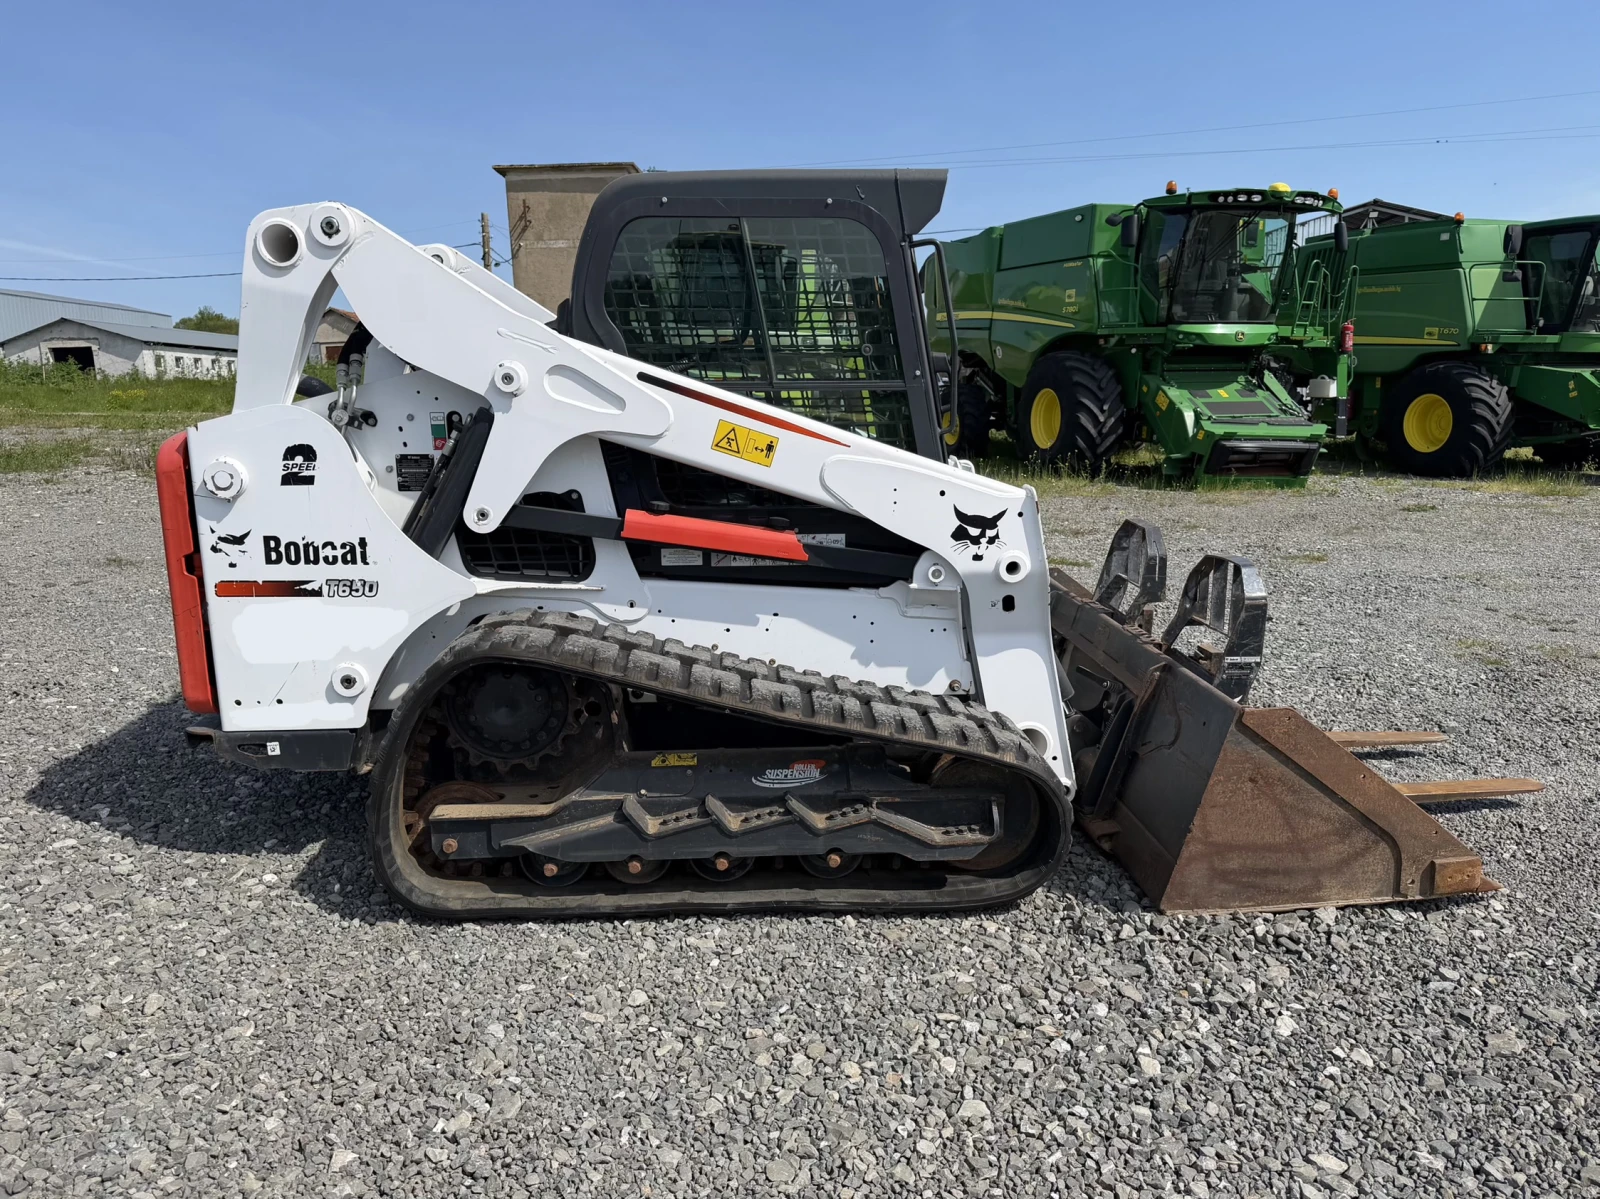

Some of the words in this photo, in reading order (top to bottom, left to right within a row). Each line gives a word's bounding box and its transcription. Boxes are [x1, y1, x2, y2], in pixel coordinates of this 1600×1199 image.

[280, 443, 317, 486] 2
[262, 535, 370, 565] Bobcat
[325, 578, 379, 597] T650
[765, 768, 821, 778] SUSPENSION
